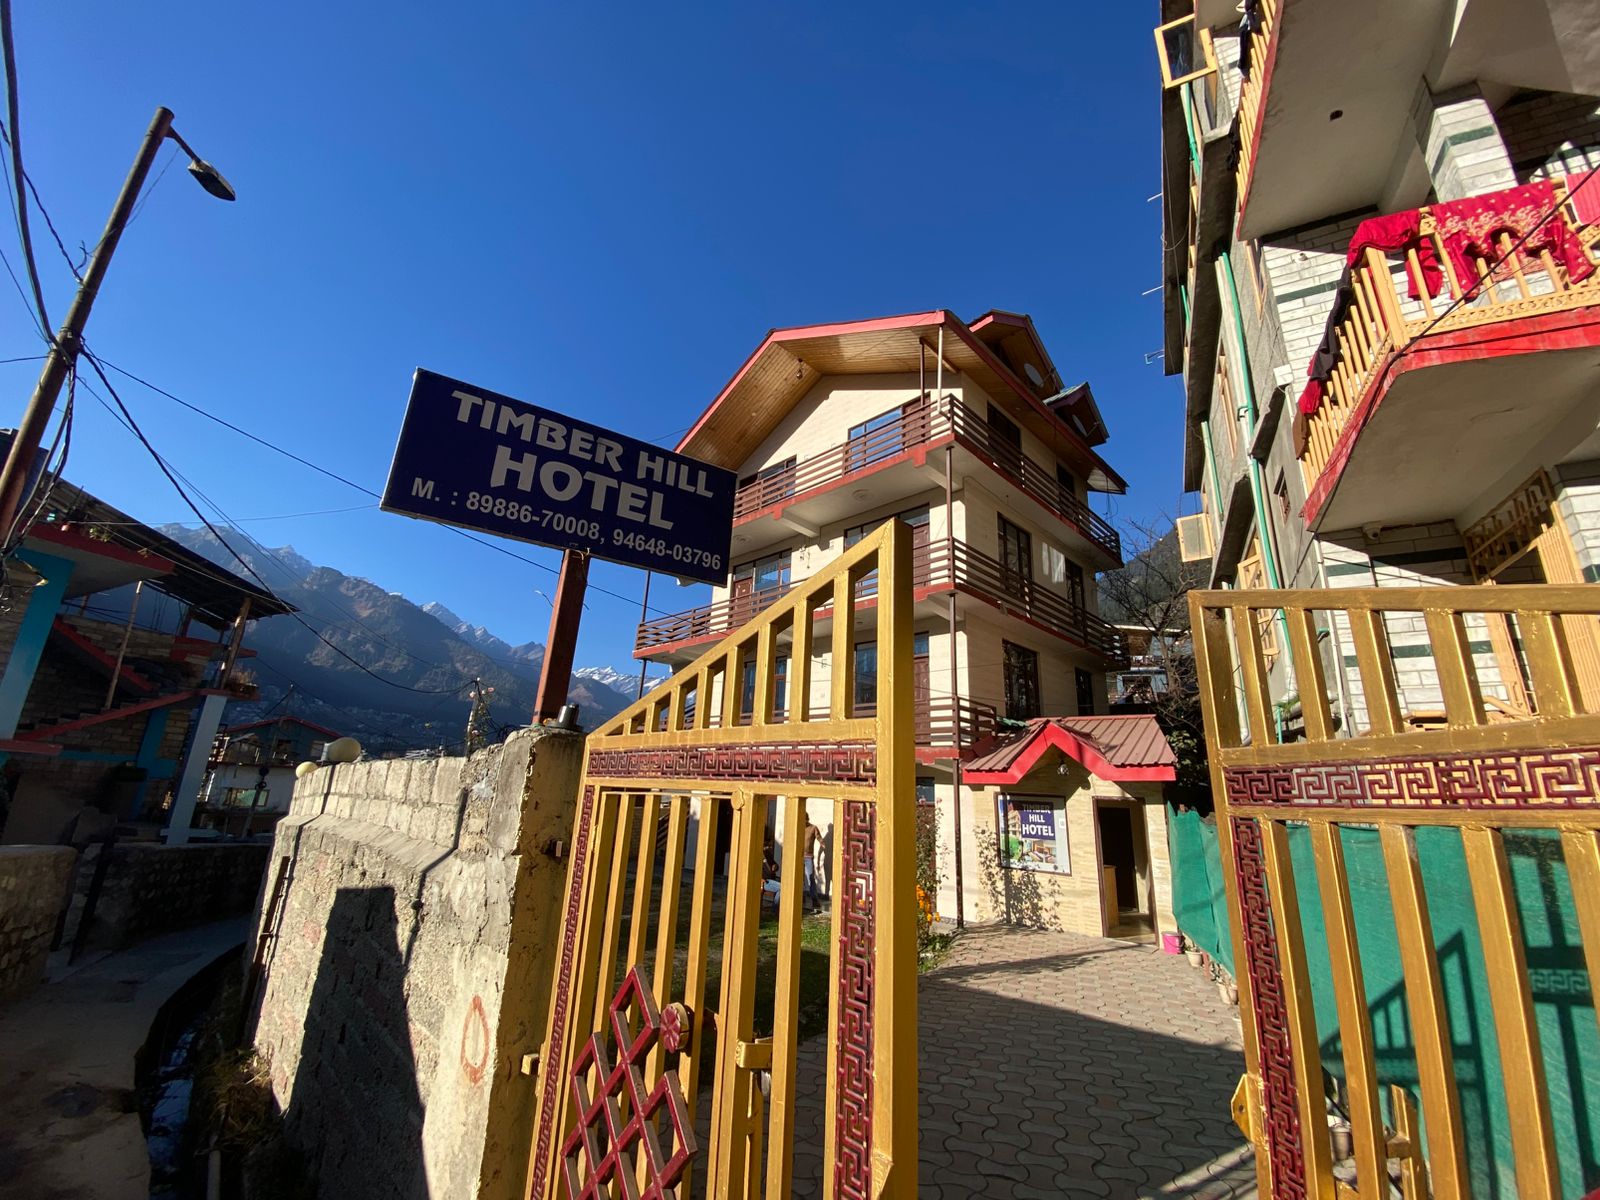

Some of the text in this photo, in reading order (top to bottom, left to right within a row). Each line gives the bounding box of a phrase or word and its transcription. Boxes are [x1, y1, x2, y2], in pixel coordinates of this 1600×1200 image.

[451, 389, 714, 498] TIMBER HILL
[490, 445, 674, 530] HOTEL
[465, 491, 605, 544] 89886-70008,
[612, 528, 722, 570] 94648-03796
[1022, 804, 1051, 814] TIMBER
[1022, 824, 1054, 836] HOTEL
[1029, 814, 1045, 823] HILL
